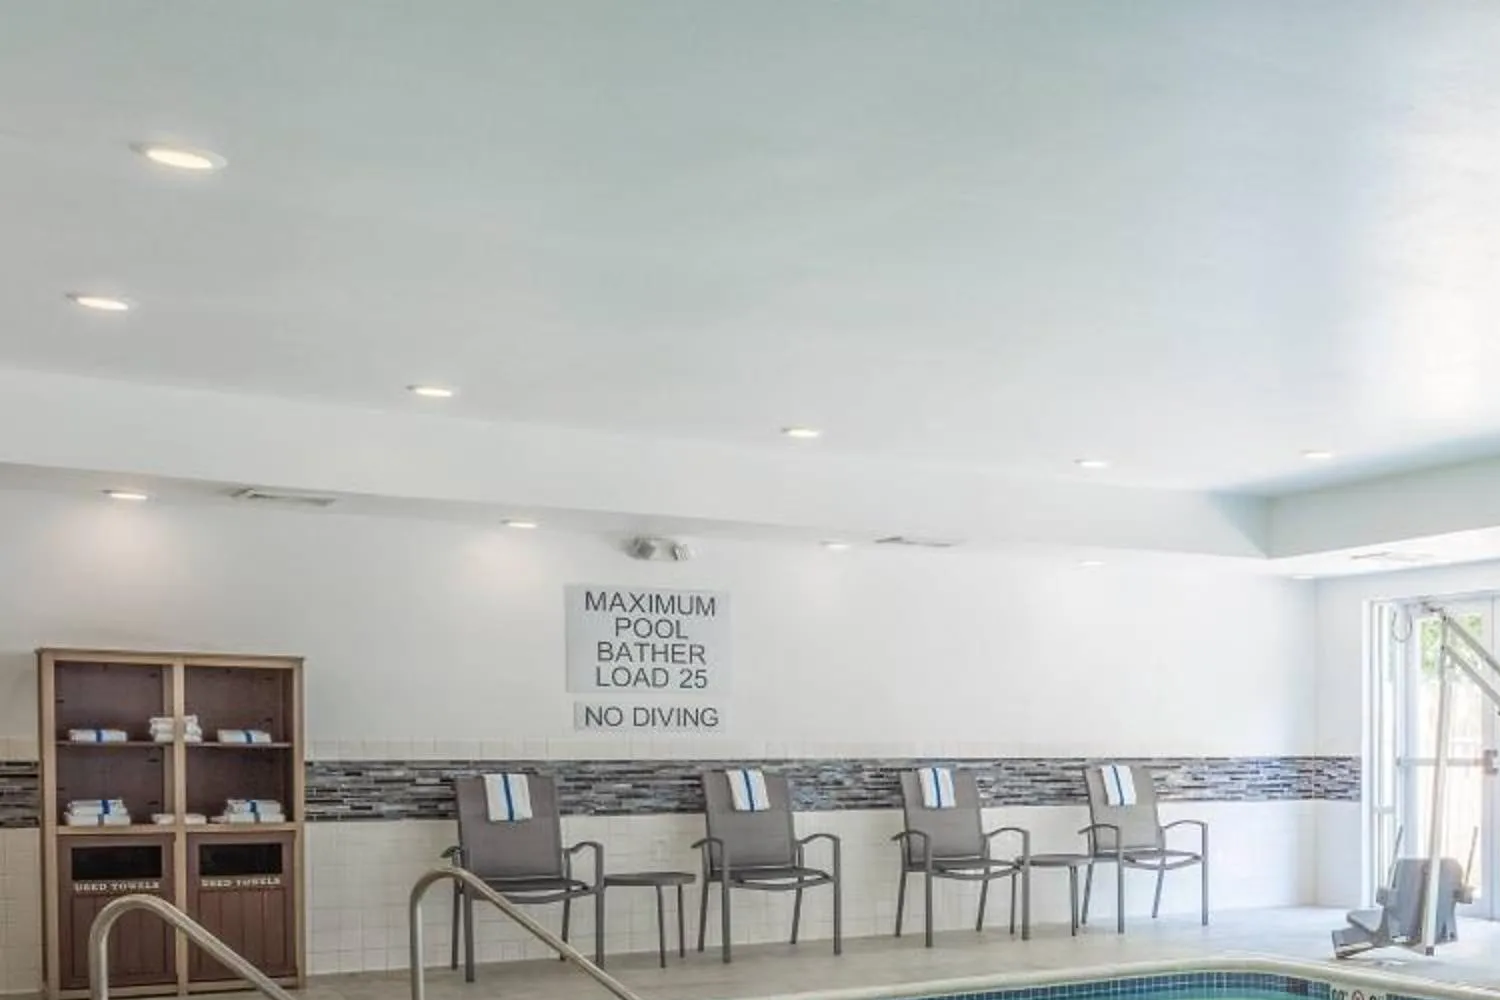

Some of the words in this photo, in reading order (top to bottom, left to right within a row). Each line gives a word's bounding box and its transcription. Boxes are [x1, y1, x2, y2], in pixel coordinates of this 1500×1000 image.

[585, 591, 716, 617] MAXIMUM
[614, 617, 689, 640] POOL
[597, 641, 707, 665] BATHER
[595, 666, 669, 688] LOAD
[679, 668, 708, 689] 25
[584, 706, 623, 727] NO
[632, 706, 719, 727] DIVING
[74, 882, 108, 892] USED
[111, 881, 161, 891] TOWELS
